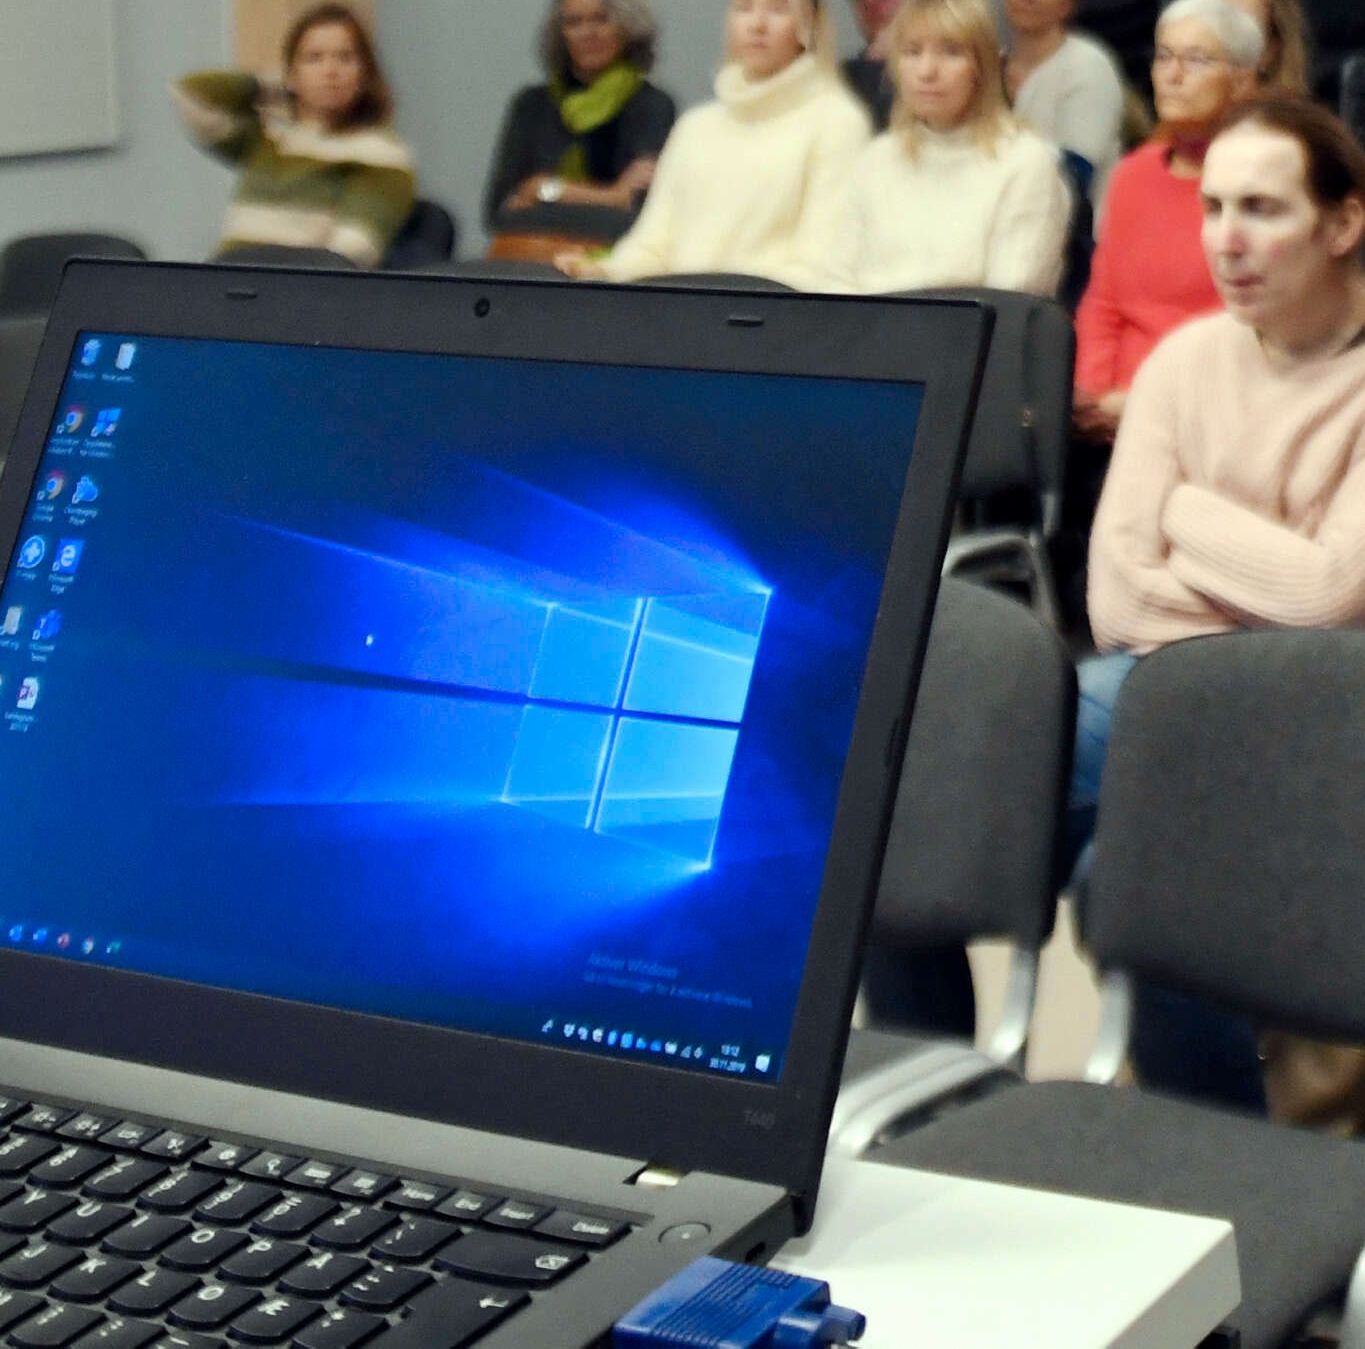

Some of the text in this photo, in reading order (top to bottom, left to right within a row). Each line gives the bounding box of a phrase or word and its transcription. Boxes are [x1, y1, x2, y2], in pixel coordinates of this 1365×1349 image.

[24, 1189, 47, 1205] Y
[76, 1202, 103, 1217] U
[191, 1229, 215, 1244] O
[247, 1237, 272, 1254] P
[80, 1258, 107, 1274] K
[136, 1270, 156, 1287] L
